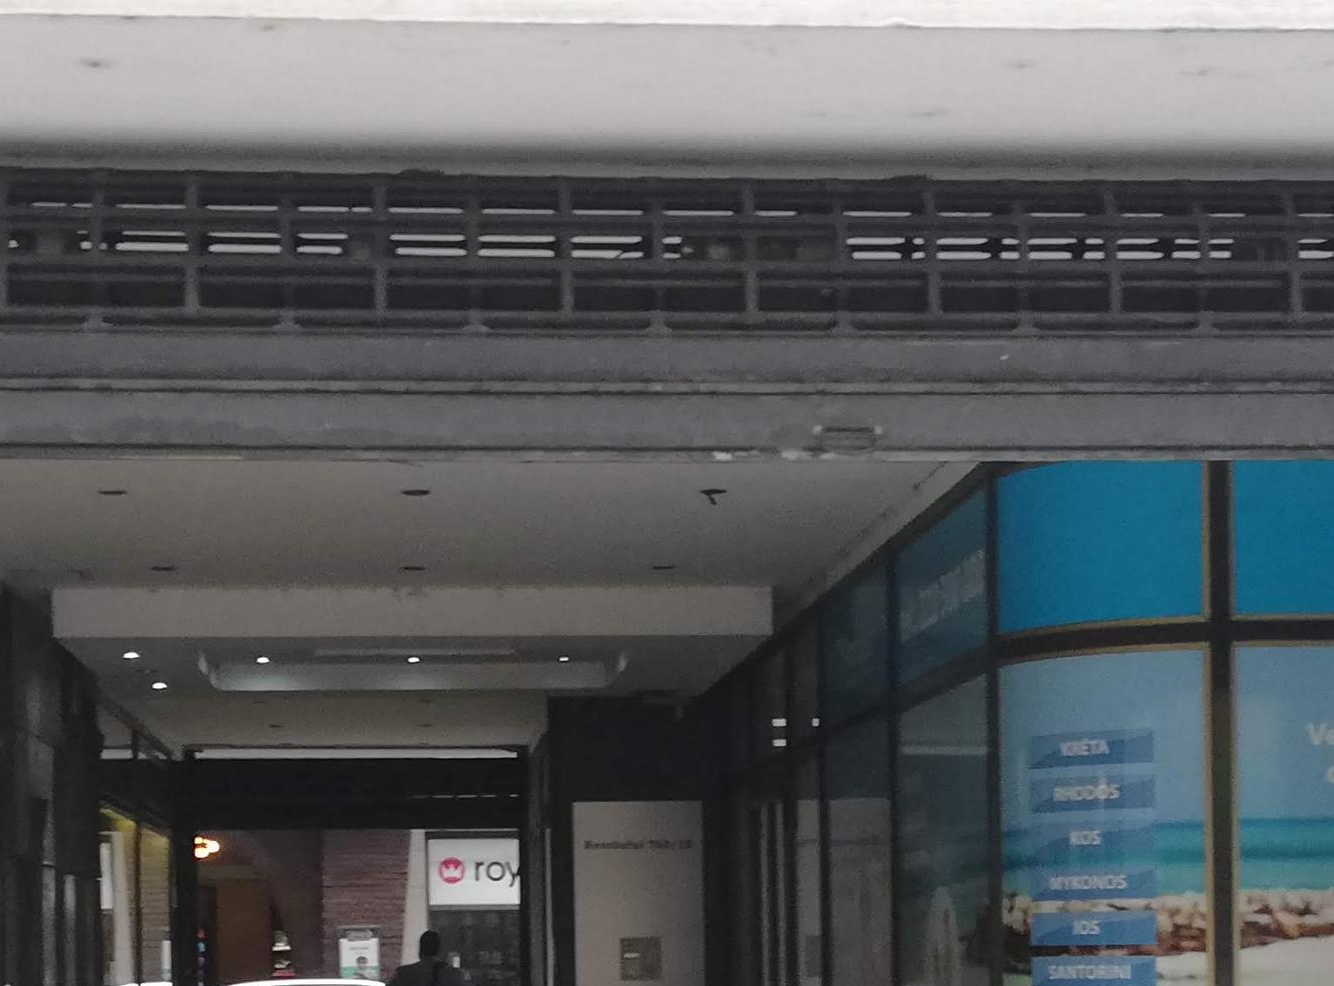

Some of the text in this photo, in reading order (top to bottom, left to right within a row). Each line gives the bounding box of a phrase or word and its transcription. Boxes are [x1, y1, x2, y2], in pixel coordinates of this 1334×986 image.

[1070, 830, 1102, 846] KOS
[1050, 875, 1128, 891] MYKONOS
[1048, 964, 1132, 981] SANTORINI
